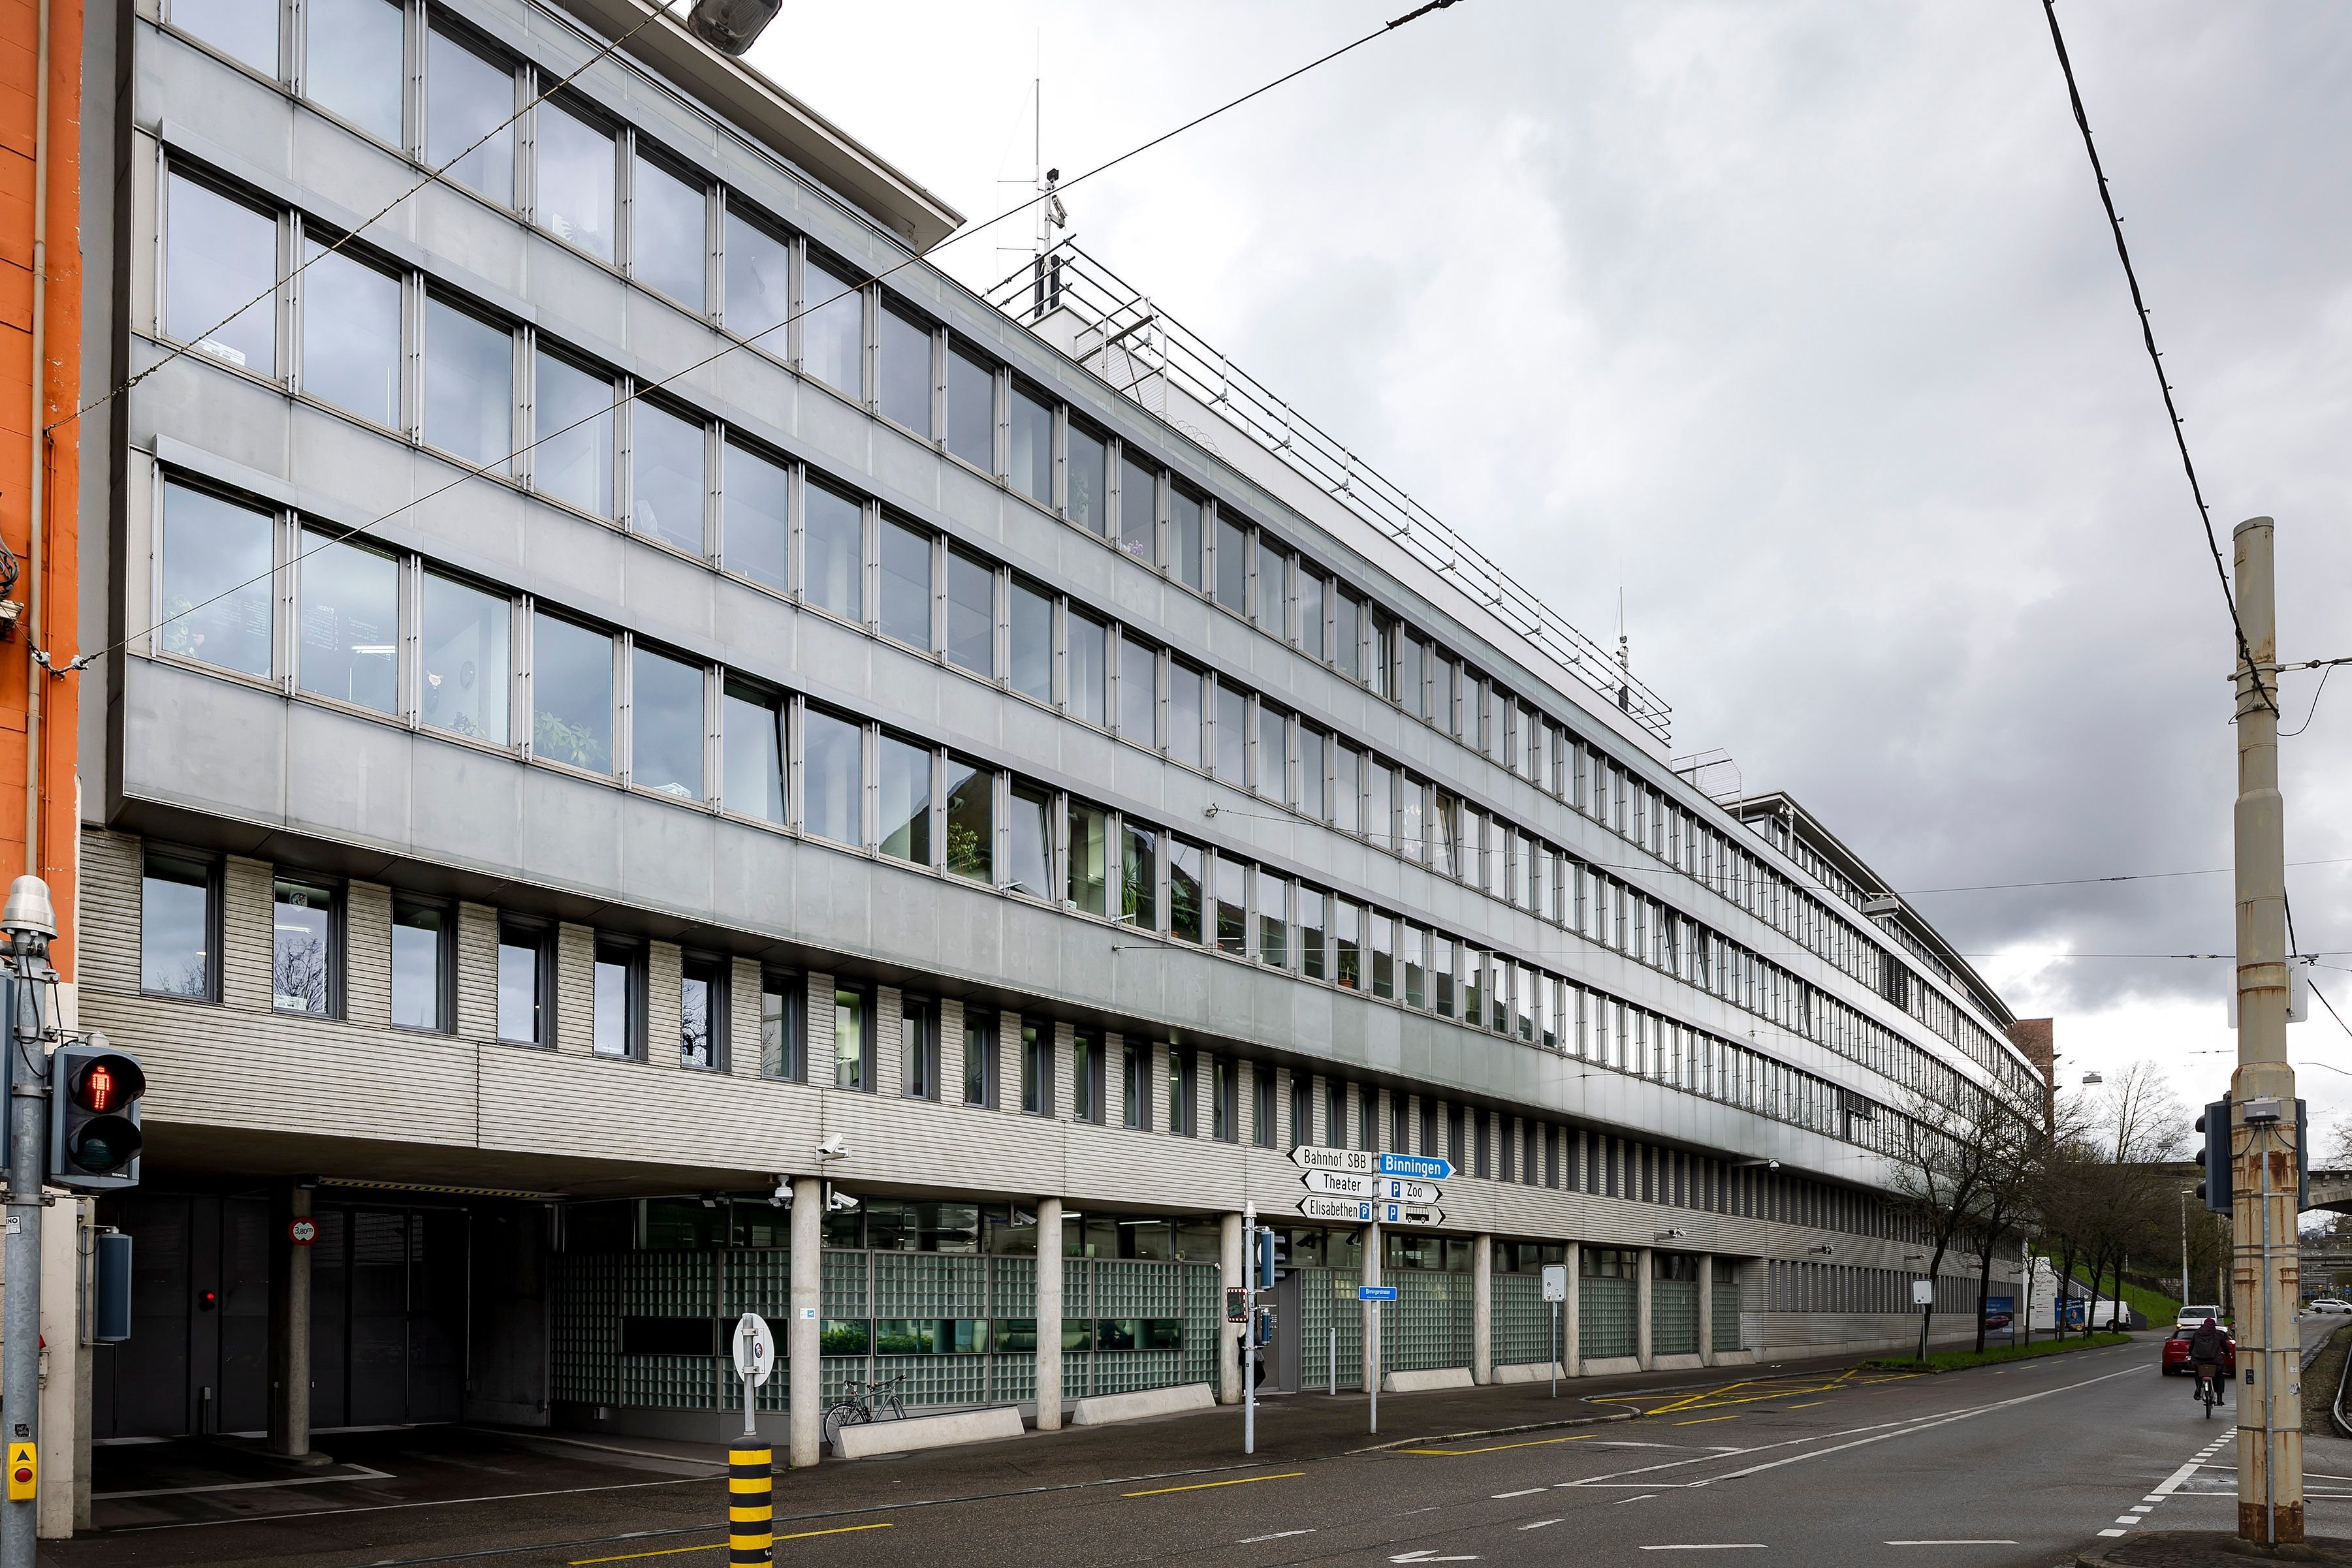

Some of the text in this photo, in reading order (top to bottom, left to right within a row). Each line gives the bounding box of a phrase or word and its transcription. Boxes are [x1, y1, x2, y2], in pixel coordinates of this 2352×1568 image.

[1304, 1149, 1366, 1168] Bahnhof SBB
[1386, 1155, 1440, 1177] Binningen
[1324, 1173, 1361, 1192] Theater
[1393, 1183, 1422, 1198] P Zoo
[1310, 1199, 1367, 1217] Elisabethen P
[1390, 1207, 1396, 1219] P
